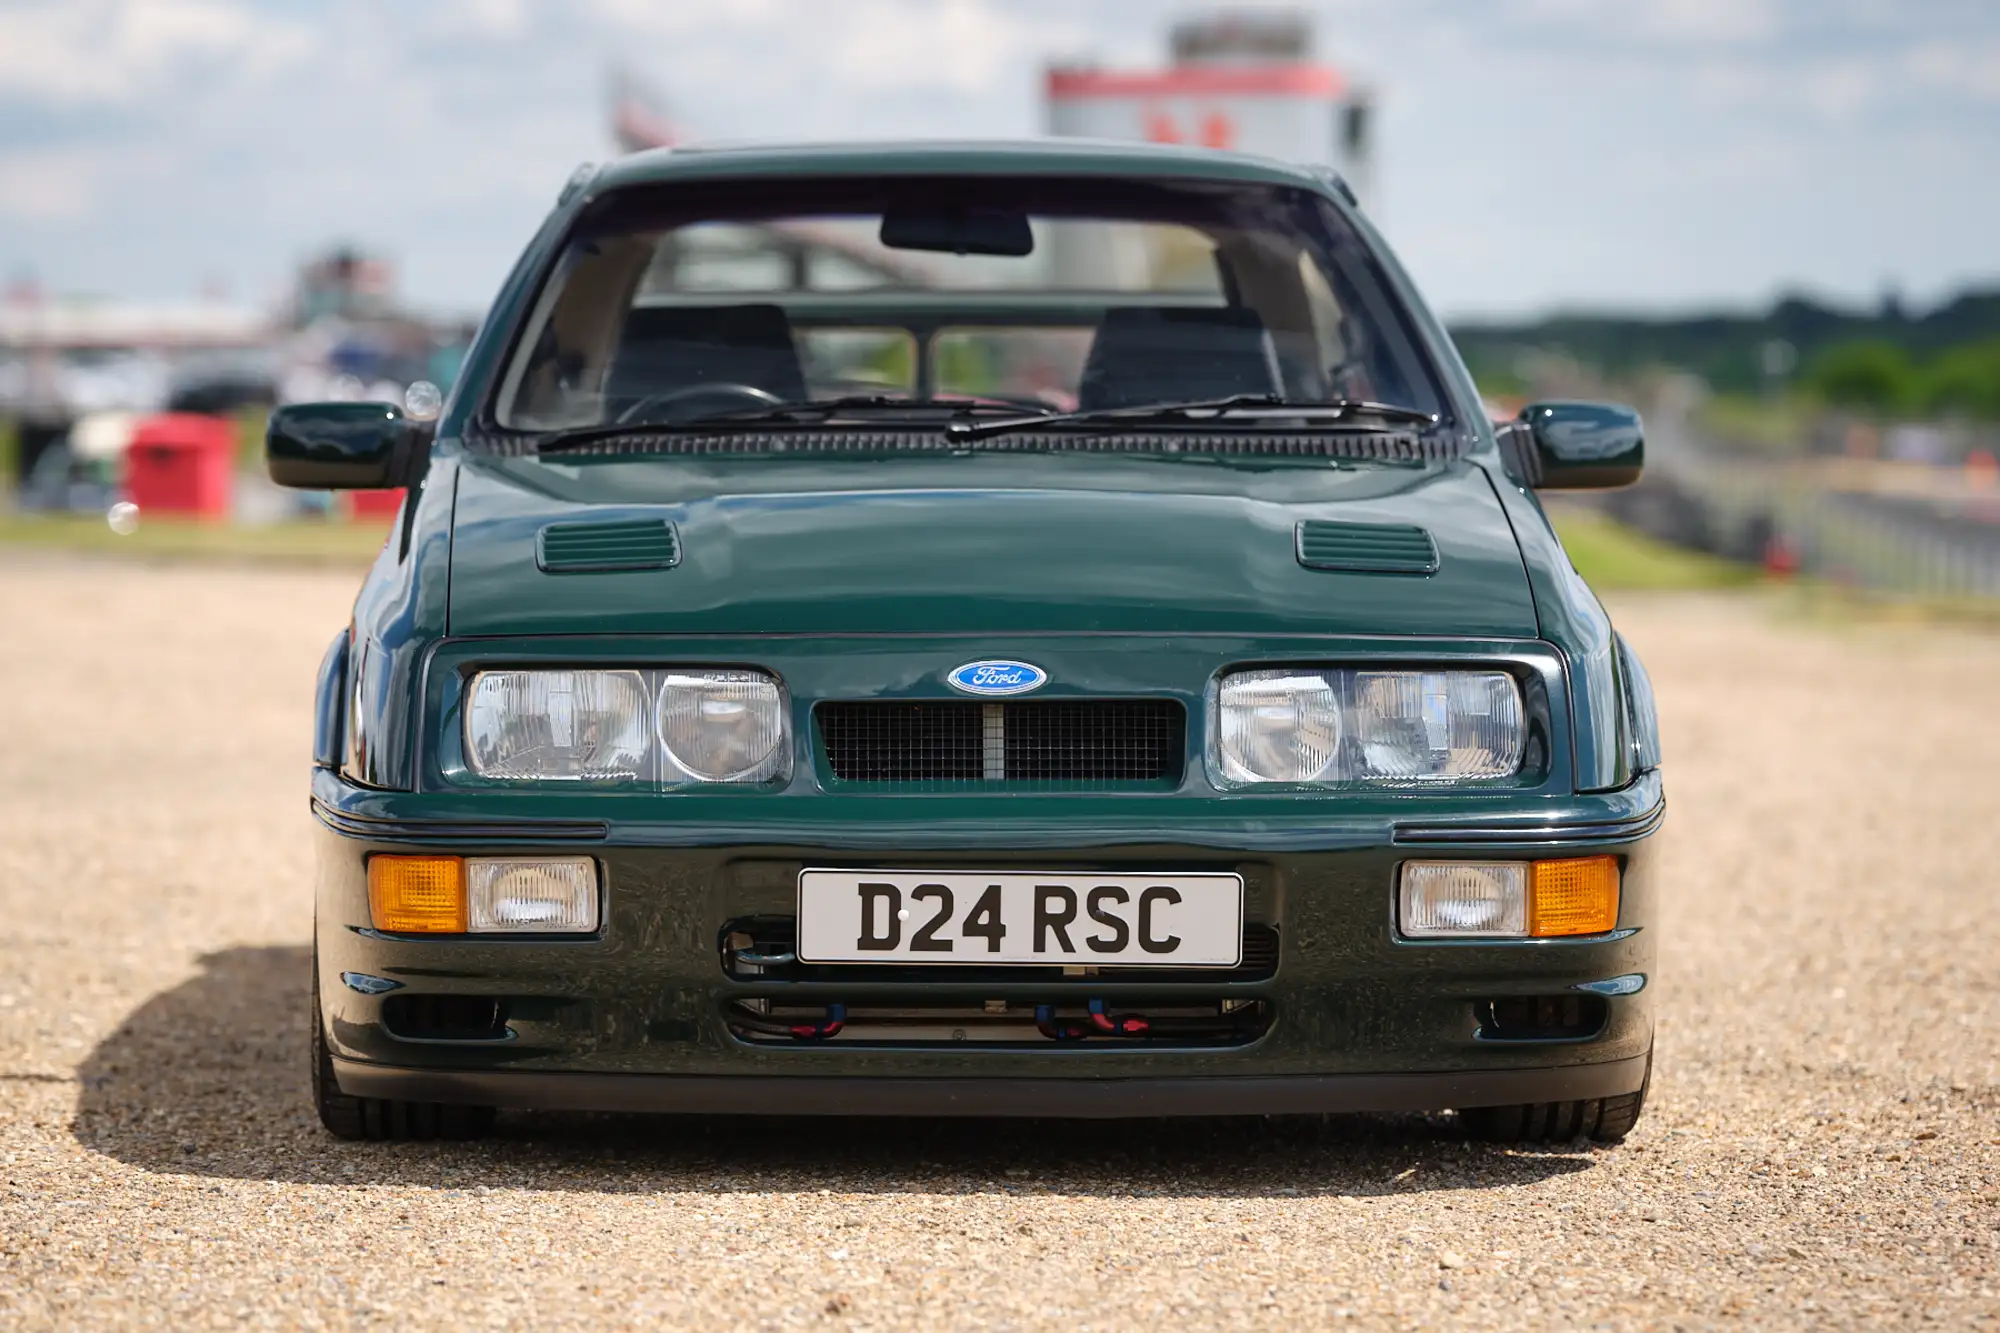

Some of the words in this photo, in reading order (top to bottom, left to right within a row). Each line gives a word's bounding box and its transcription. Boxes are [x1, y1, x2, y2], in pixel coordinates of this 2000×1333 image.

[972, 666, 1023, 685] Ford
[857, 882, 1006, 953] D24
[1032, 885, 1182, 954] RSC
